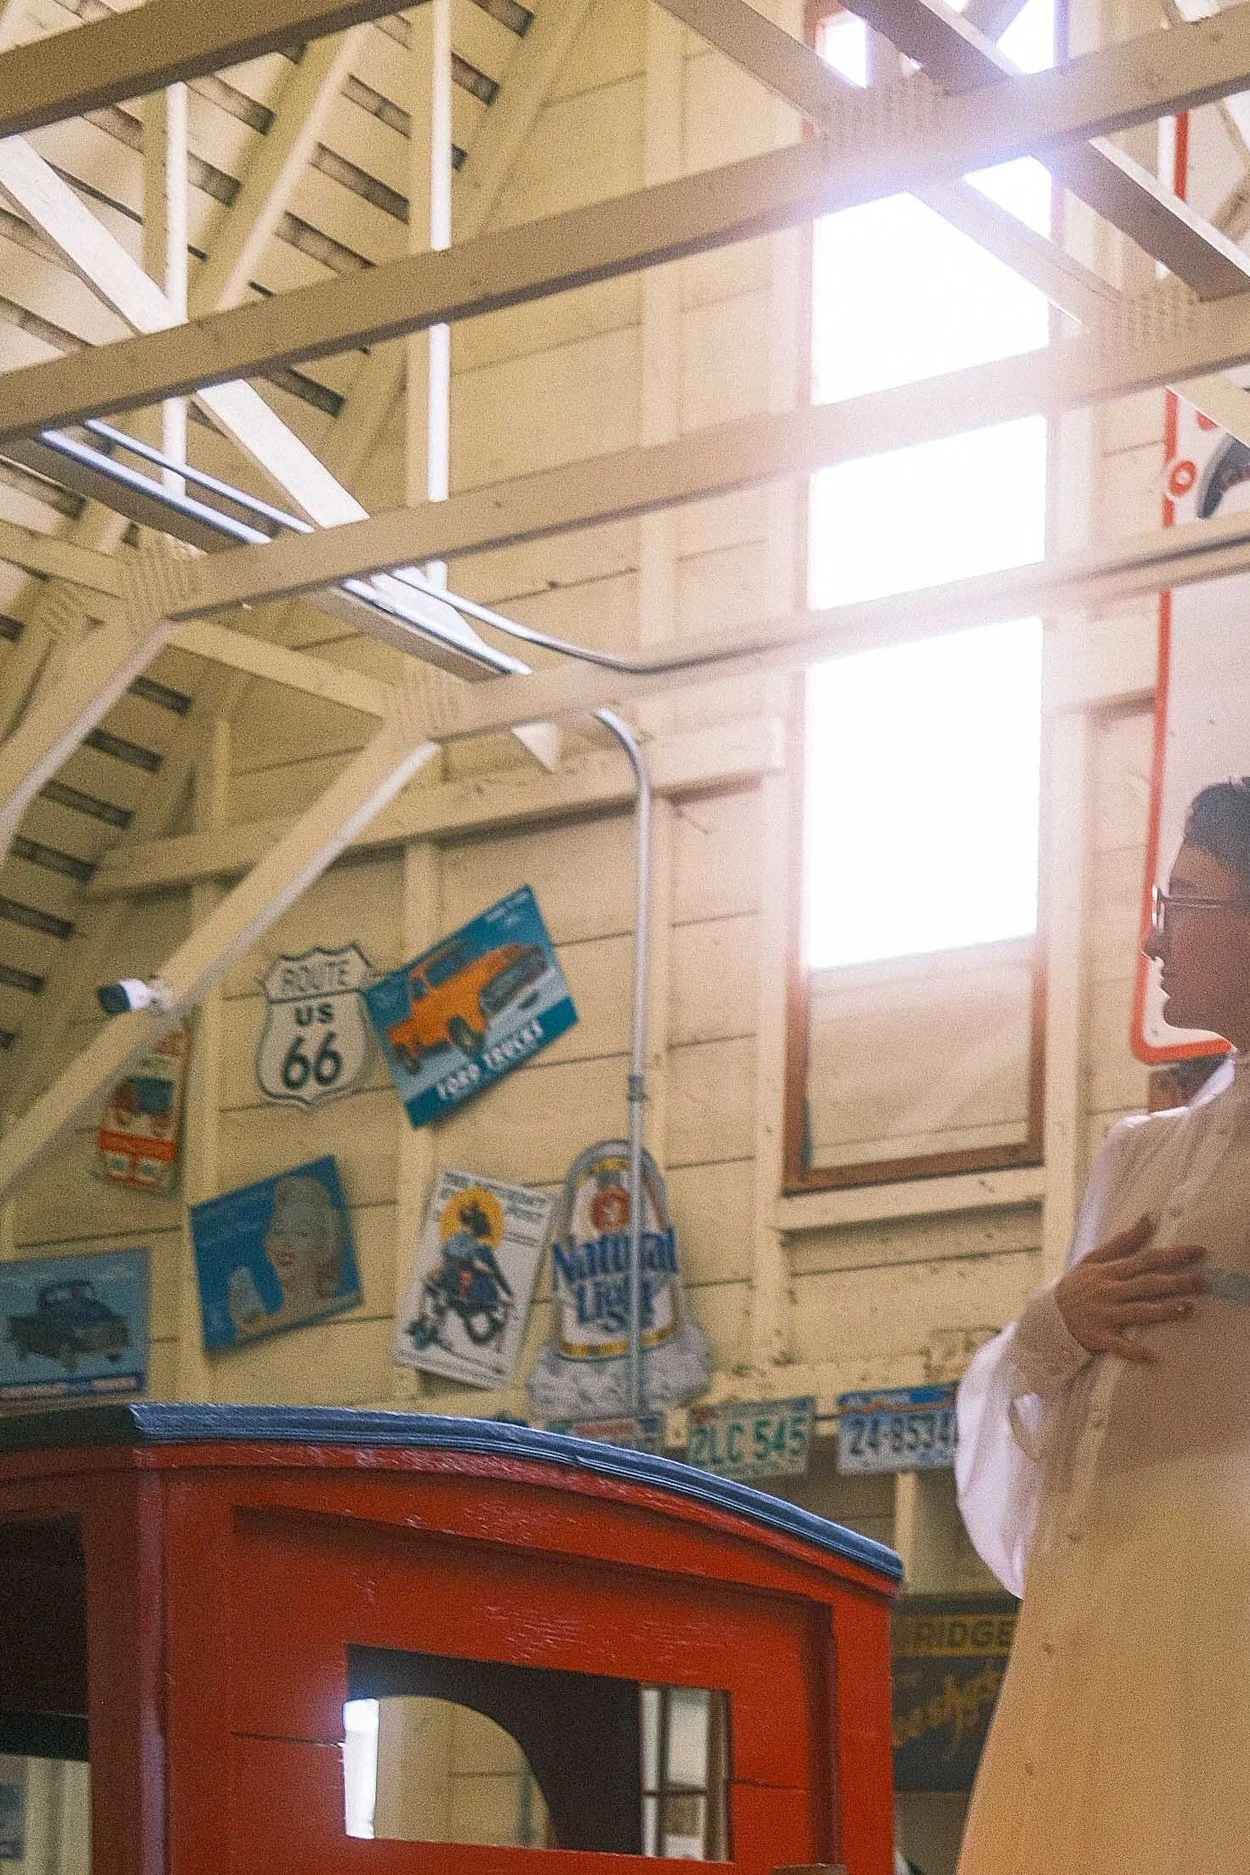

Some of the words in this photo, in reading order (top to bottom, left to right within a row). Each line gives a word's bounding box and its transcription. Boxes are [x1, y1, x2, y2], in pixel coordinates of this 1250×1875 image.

[281, 959, 350, 995] ROUTE
[293, 1002, 335, 1028] US
[281, 1031, 343, 1090] 66
